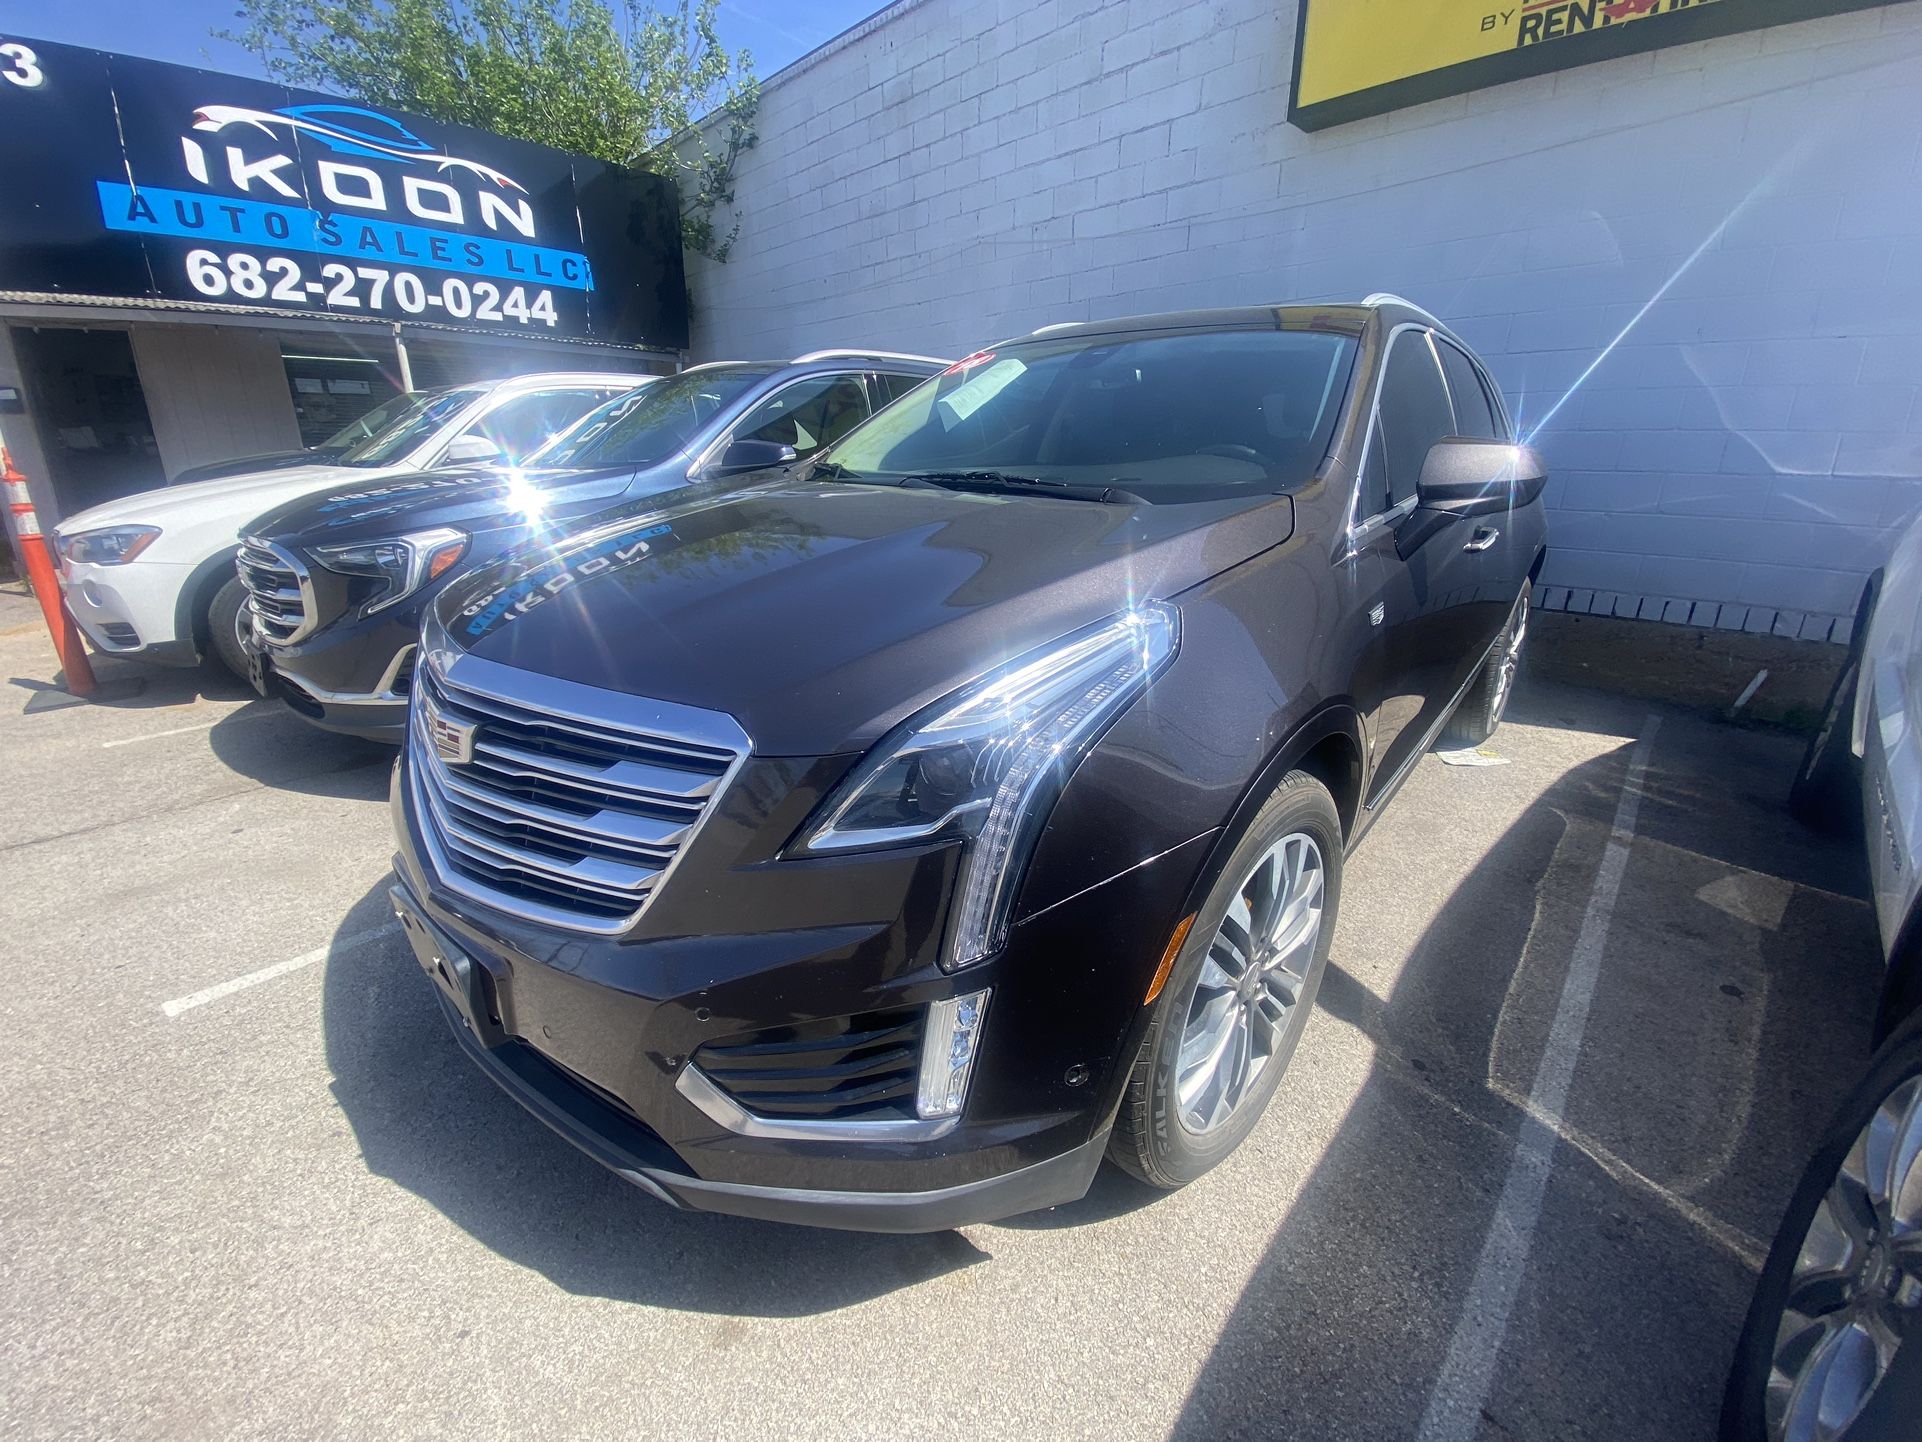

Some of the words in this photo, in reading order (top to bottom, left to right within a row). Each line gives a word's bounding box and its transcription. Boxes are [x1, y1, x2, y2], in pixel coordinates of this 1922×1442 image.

[1480, 8, 1515, 32] BY
[0, 43, 44, 87] 3
[181, 136, 536, 238] IKOON
[127, 194, 289, 240] AUTO
[317, 218, 484, 267] SALES
[505, 249, 578, 281] LLC
[185, 249, 558, 327] 682-270-0244
